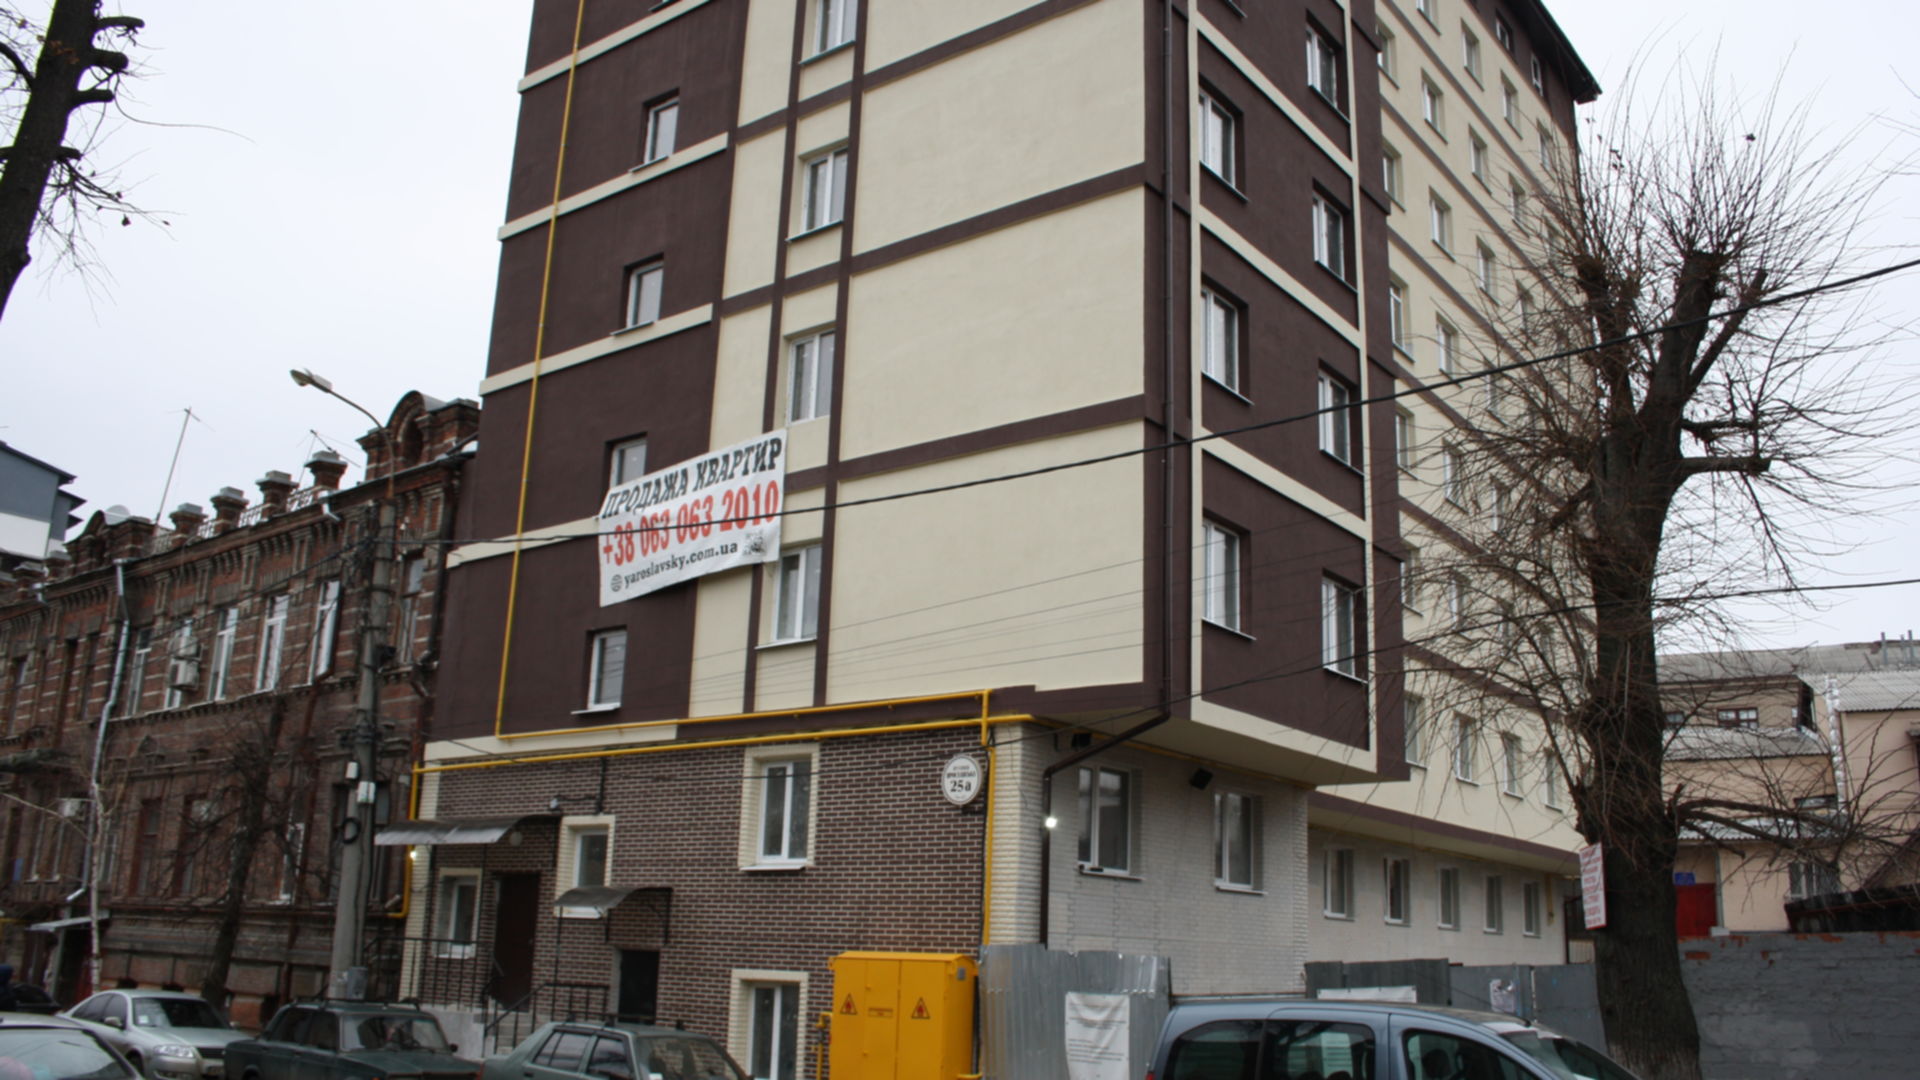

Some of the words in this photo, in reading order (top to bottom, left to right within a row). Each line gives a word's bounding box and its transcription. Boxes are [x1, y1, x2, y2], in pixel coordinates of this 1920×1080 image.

[602, 468, 688, 519] ПРОДАЖА
[693, 437, 782, 492] КВАРТИР
[603, 521, 635, 567] +38
[640, 509, 670, 557] 063
[676, 495, 714, 544] 063
[720, 480, 779, 532] 2010
[624, 541, 738, 588] yaroslavsky.com.ua
